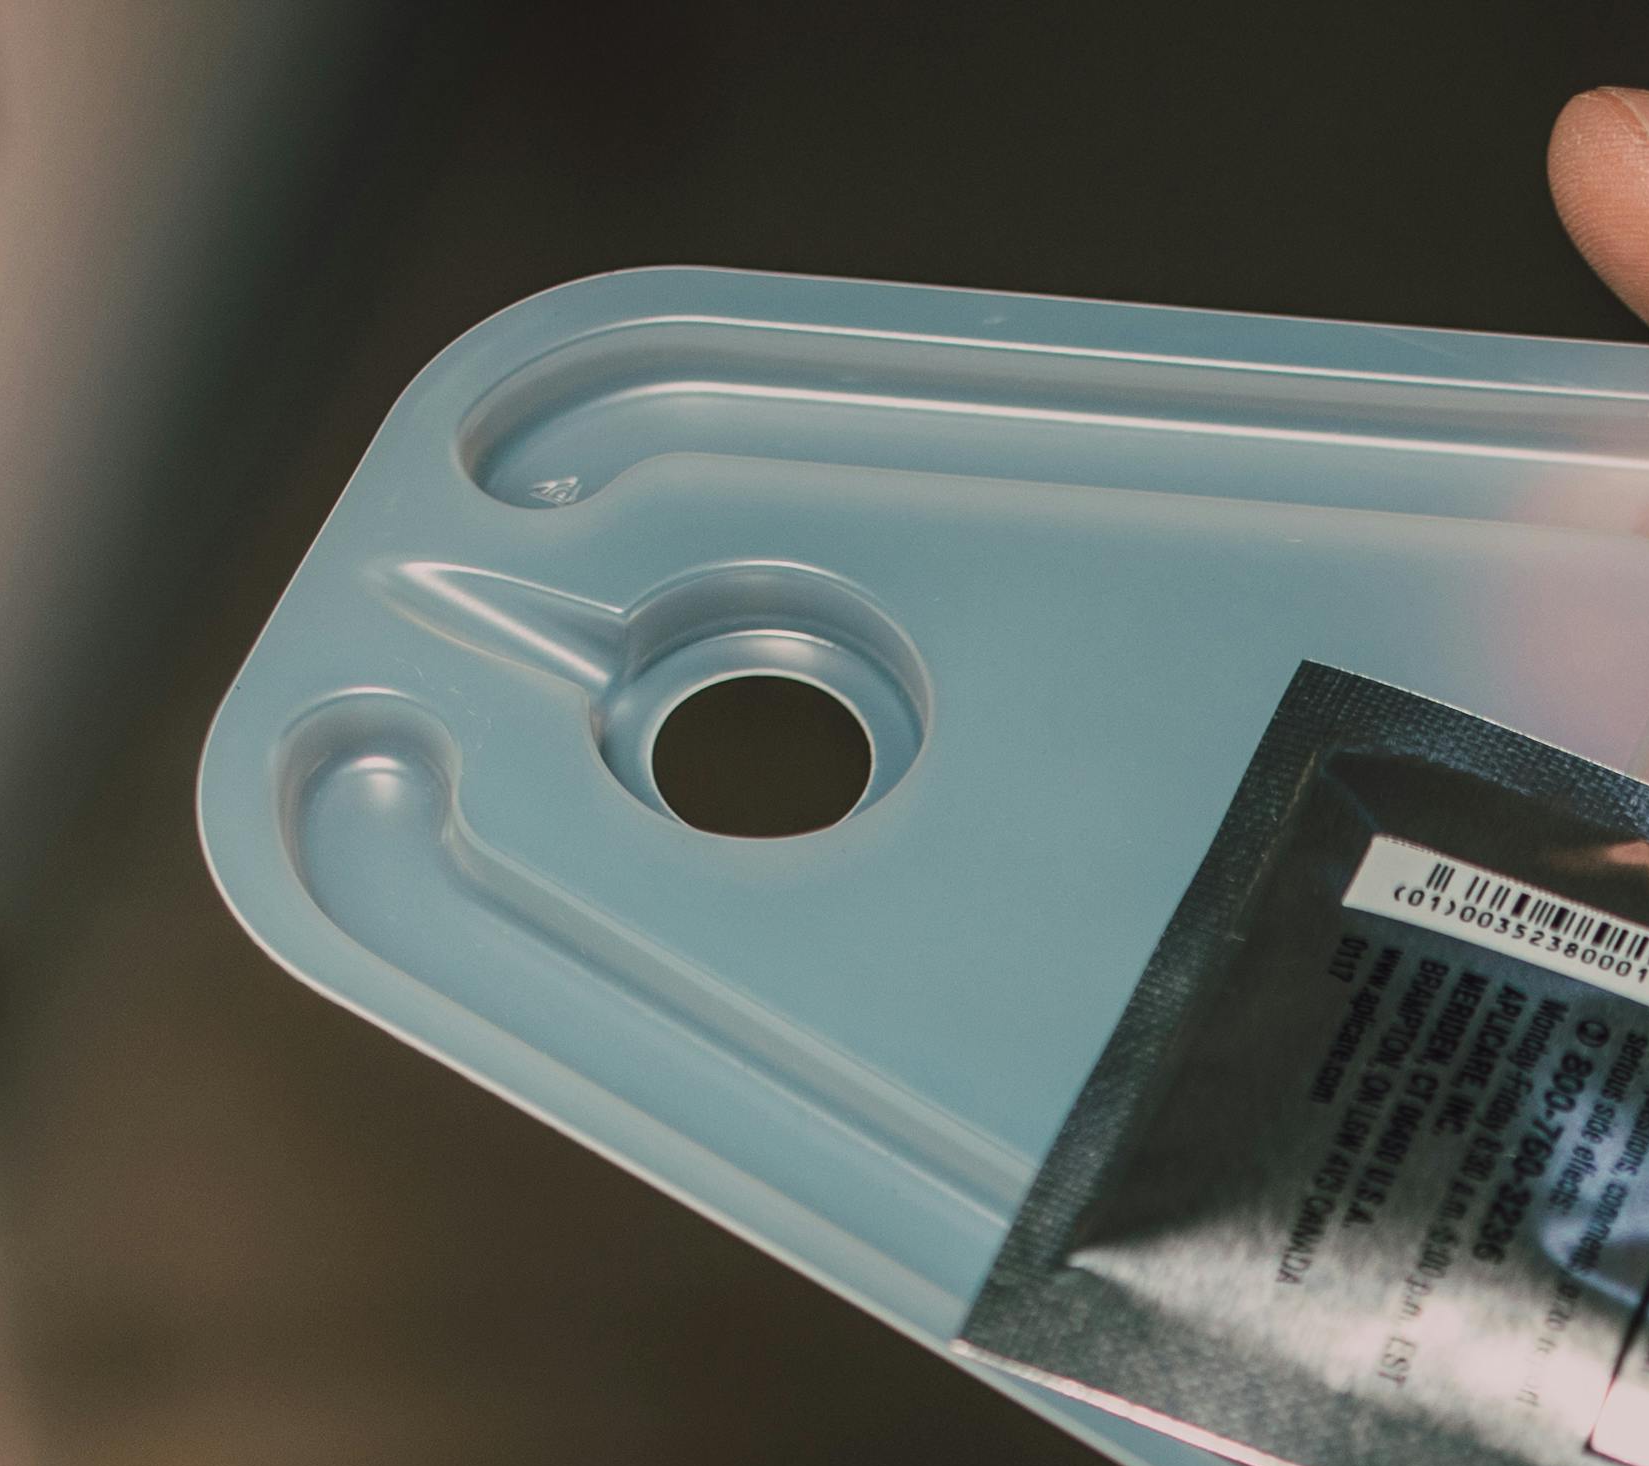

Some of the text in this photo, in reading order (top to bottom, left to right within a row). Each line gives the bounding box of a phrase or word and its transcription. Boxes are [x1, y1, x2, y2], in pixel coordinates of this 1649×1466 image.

[1311, 945, 1401, 1107] www.aplicare.com
[1372, 955, 1450, 1076] BRAMPTON,
[1418, 967, 1490, 1074] MERIDEN,
[1433, 982, 1530, 1142] APLICARE, INC.
[1481, 995, 1568, 1136] Monday-Friday
[1355, 1072, 1392, 1110] ON
[1405, 1071, 1440, 1106] CT
[1548, 1030, 1649, 1216] serious side effects:
[1343, 1164, 1392, 1236] U.S.A.
[1463, 1134, 1503, 1185] 8:30
[1476, 1053, 1593, 1264] 800-760-3236
[1275, 1193, 1335, 1290] CANADA
[1374, 1334, 1415, 1386] EST
